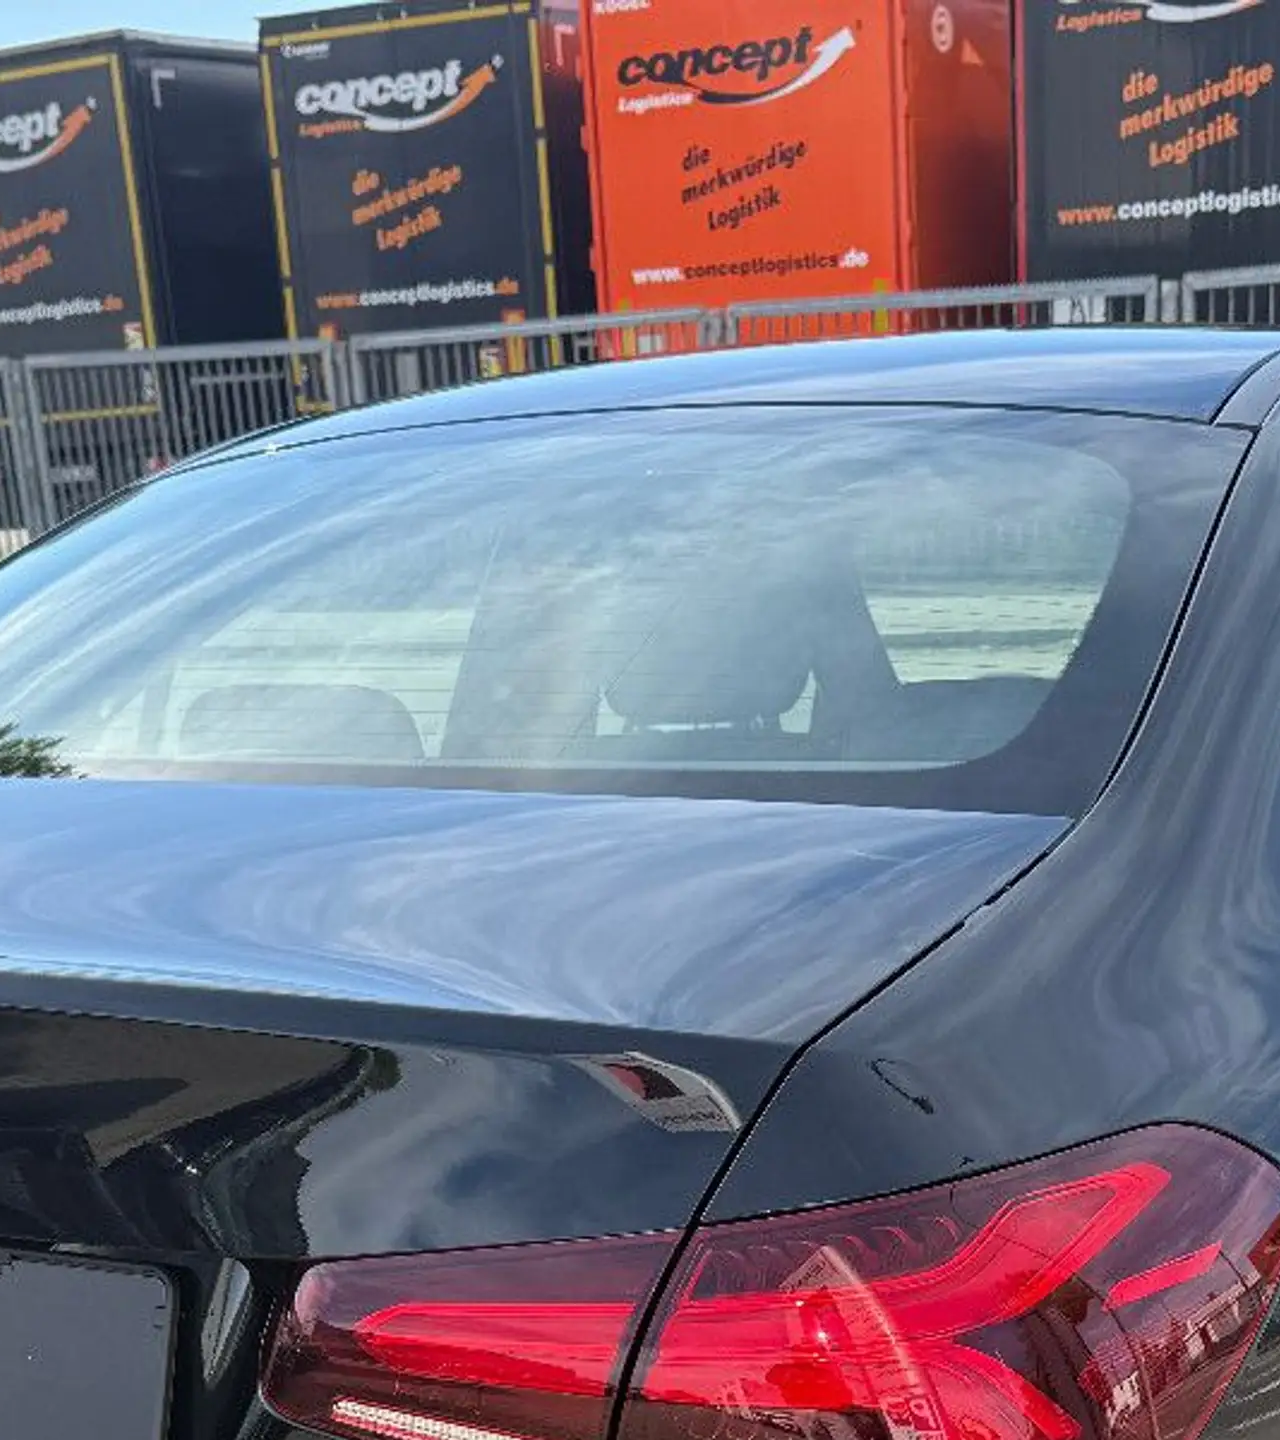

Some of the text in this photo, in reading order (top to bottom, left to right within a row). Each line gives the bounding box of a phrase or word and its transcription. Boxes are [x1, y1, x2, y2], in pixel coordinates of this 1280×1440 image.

[1055, 8, 1143, 33] Logistics
[616, 26, 813, 86] concept
[294, 59, 462, 115] concept
[1119, 61, 1275, 138] merkwürdige
[1122, 70, 1159, 102] die
[681, 145, 711, 172] die
[1148, 112, 1241, 168] Logistik
[351, 169, 380, 196] die
[680, 140, 809, 205] merkwürdige
[708, 185, 782, 231] Logistik
[631, 246, 870, 286] www.conceptlogistics.de
